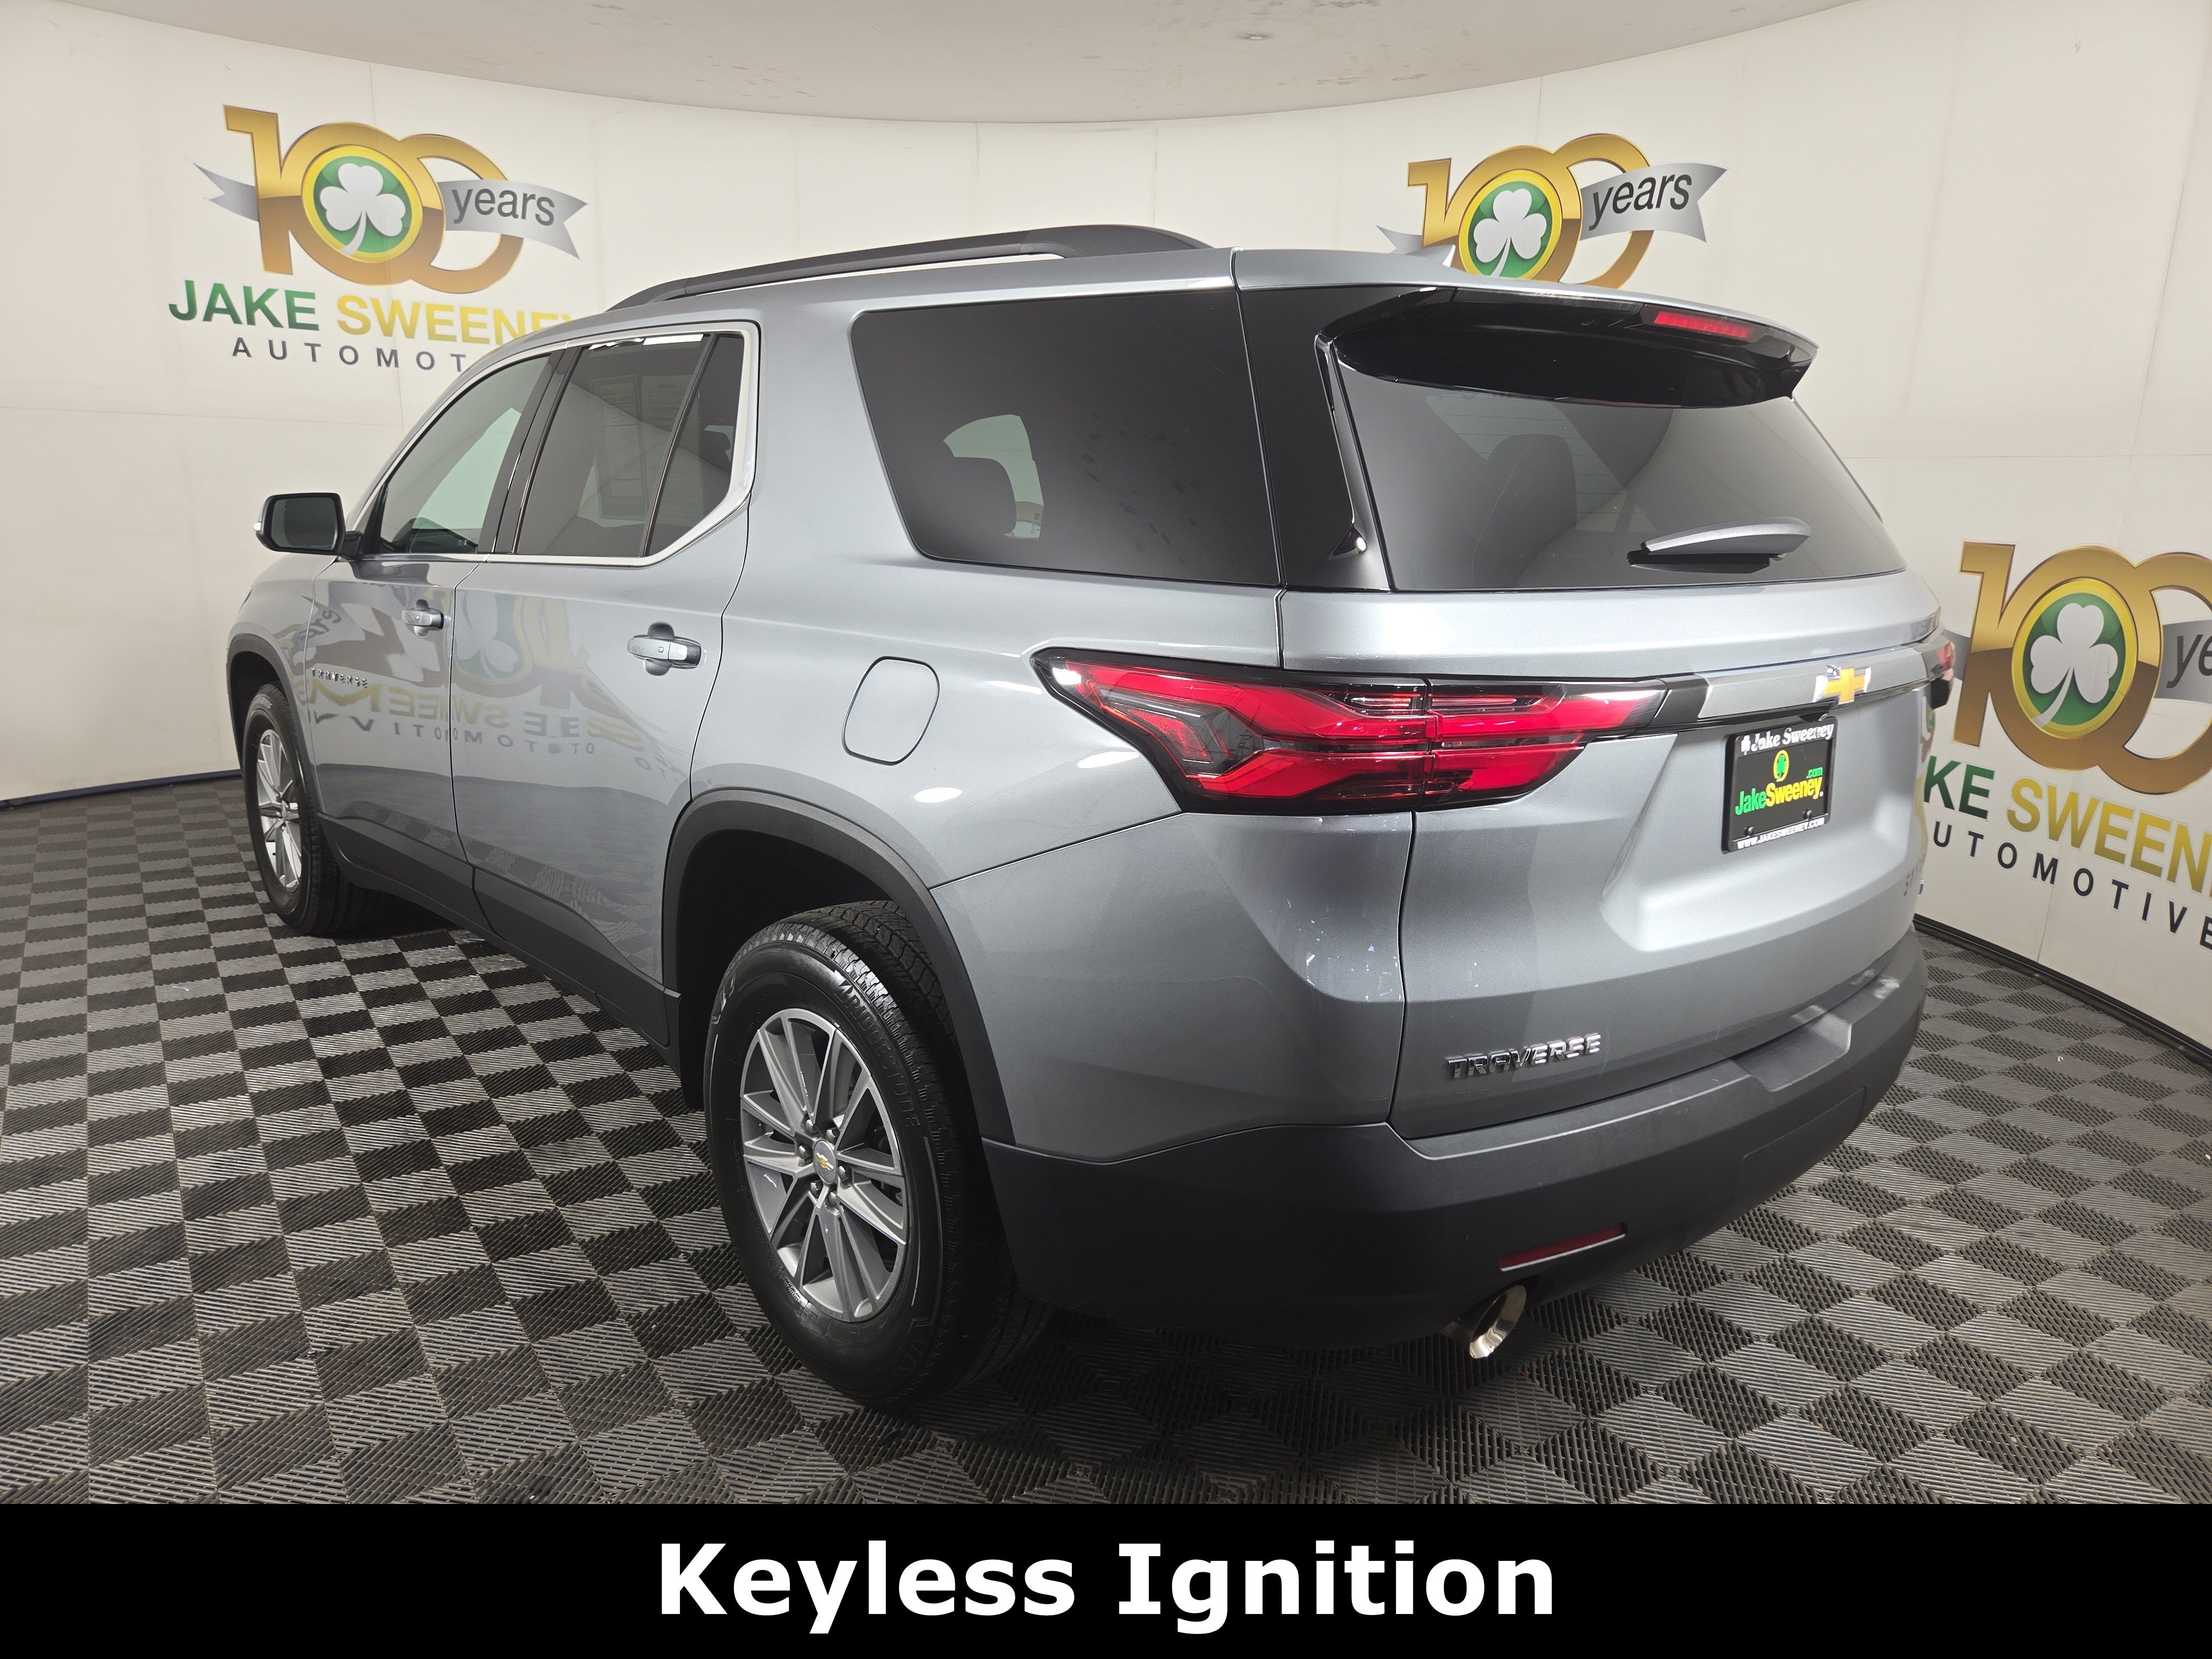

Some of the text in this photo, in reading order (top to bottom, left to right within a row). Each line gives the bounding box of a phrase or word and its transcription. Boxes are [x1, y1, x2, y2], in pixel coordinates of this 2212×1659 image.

[223, 105, 524, 293] 100
[451, 187, 556, 226] years
[1589, 173, 1692, 231] years
[168, 278, 319, 332] JAKE
[232, 336, 466, 372] AUTOMOT
[311, 667, 368, 689] TRAVERSE
[1751, 724, 1834, 752] Jake Sweeney
[1806, 767, 1823, 779] .com
[1737, 817, 1825, 849] WWW.JAKESWEENEY.COM
[1924, 755, 2212, 898] KE SWEEN
[1933, 820, 2212, 950] UTOMOTIVE
[833, 978, 921, 1127] BRIDGESTONE
[1447, 1033, 1601, 1078] TRAVERSE
